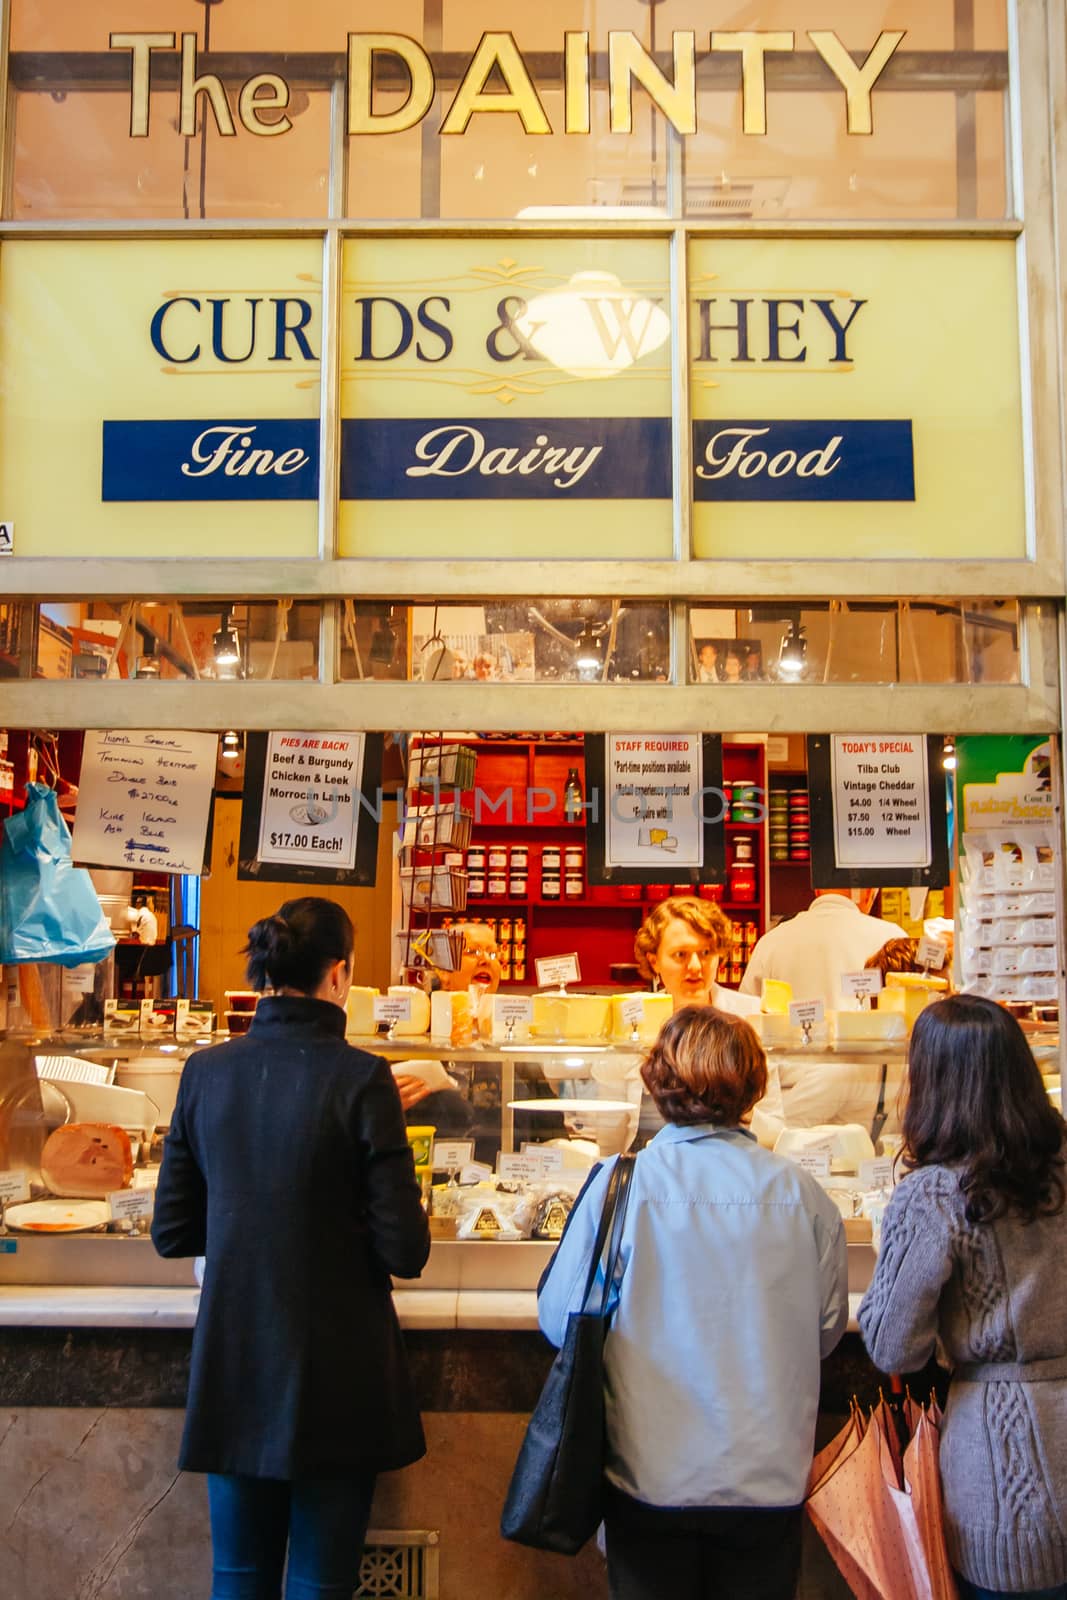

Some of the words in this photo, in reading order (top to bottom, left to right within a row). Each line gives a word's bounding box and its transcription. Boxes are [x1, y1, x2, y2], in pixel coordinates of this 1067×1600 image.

[109, 31, 293, 137] The
[346, 31, 907, 136] DAINTY
[180, 425, 310, 478] Fine
[405, 425, 603, 489] Dairy
[695, 428, 844, 479] Food
[280, 737, 300, 747] PIES
[302, 739, 320, 749] ARE
[321, 741, 349, 751] BACK!
[615, 741, 641, 751] STAFF
[644, 741, 689, 751] REQUIRED
[842, 742, 877, 752] TODAY'S
[879, 742, 914, 752] SPECIAL
[272, 753, 295, 764] Beef
[298, 755, 305, 764] &
[308, 756, 354, 770] Burgundy
[642, 760, 666, 776] positions
[667, 760, 691, 773] available
[857, 764, 878, 774] Tilba
[881, 764, 900, 774] Club
[271, 770, 311, 782] Chicken
[314, 774, 321, 783] &
[325, 775, 349, 785] Leek
[843, 780, 877, 792] Vintage
[879, 780, 915, 790] Cheddar
[269, 787, 319, 801] Morrocan
[322, 792, 351, 803] Lamb
[850, 798, 872, 807] $4.00
[879, 798, 890, 807] 1/4
[892, 798, 917, 807] Wheel
[848, 812, 870, 822] $7.50
[881, 813, 893, 821] 1/2
[895, 812, 920, 821] Wheel
[848, 827, 875, 836] $15.00
[886, 827, 911, 836] Wheel
[270, 832, 308, 848] $17.00
[311, 836, 343, 851] Each!
